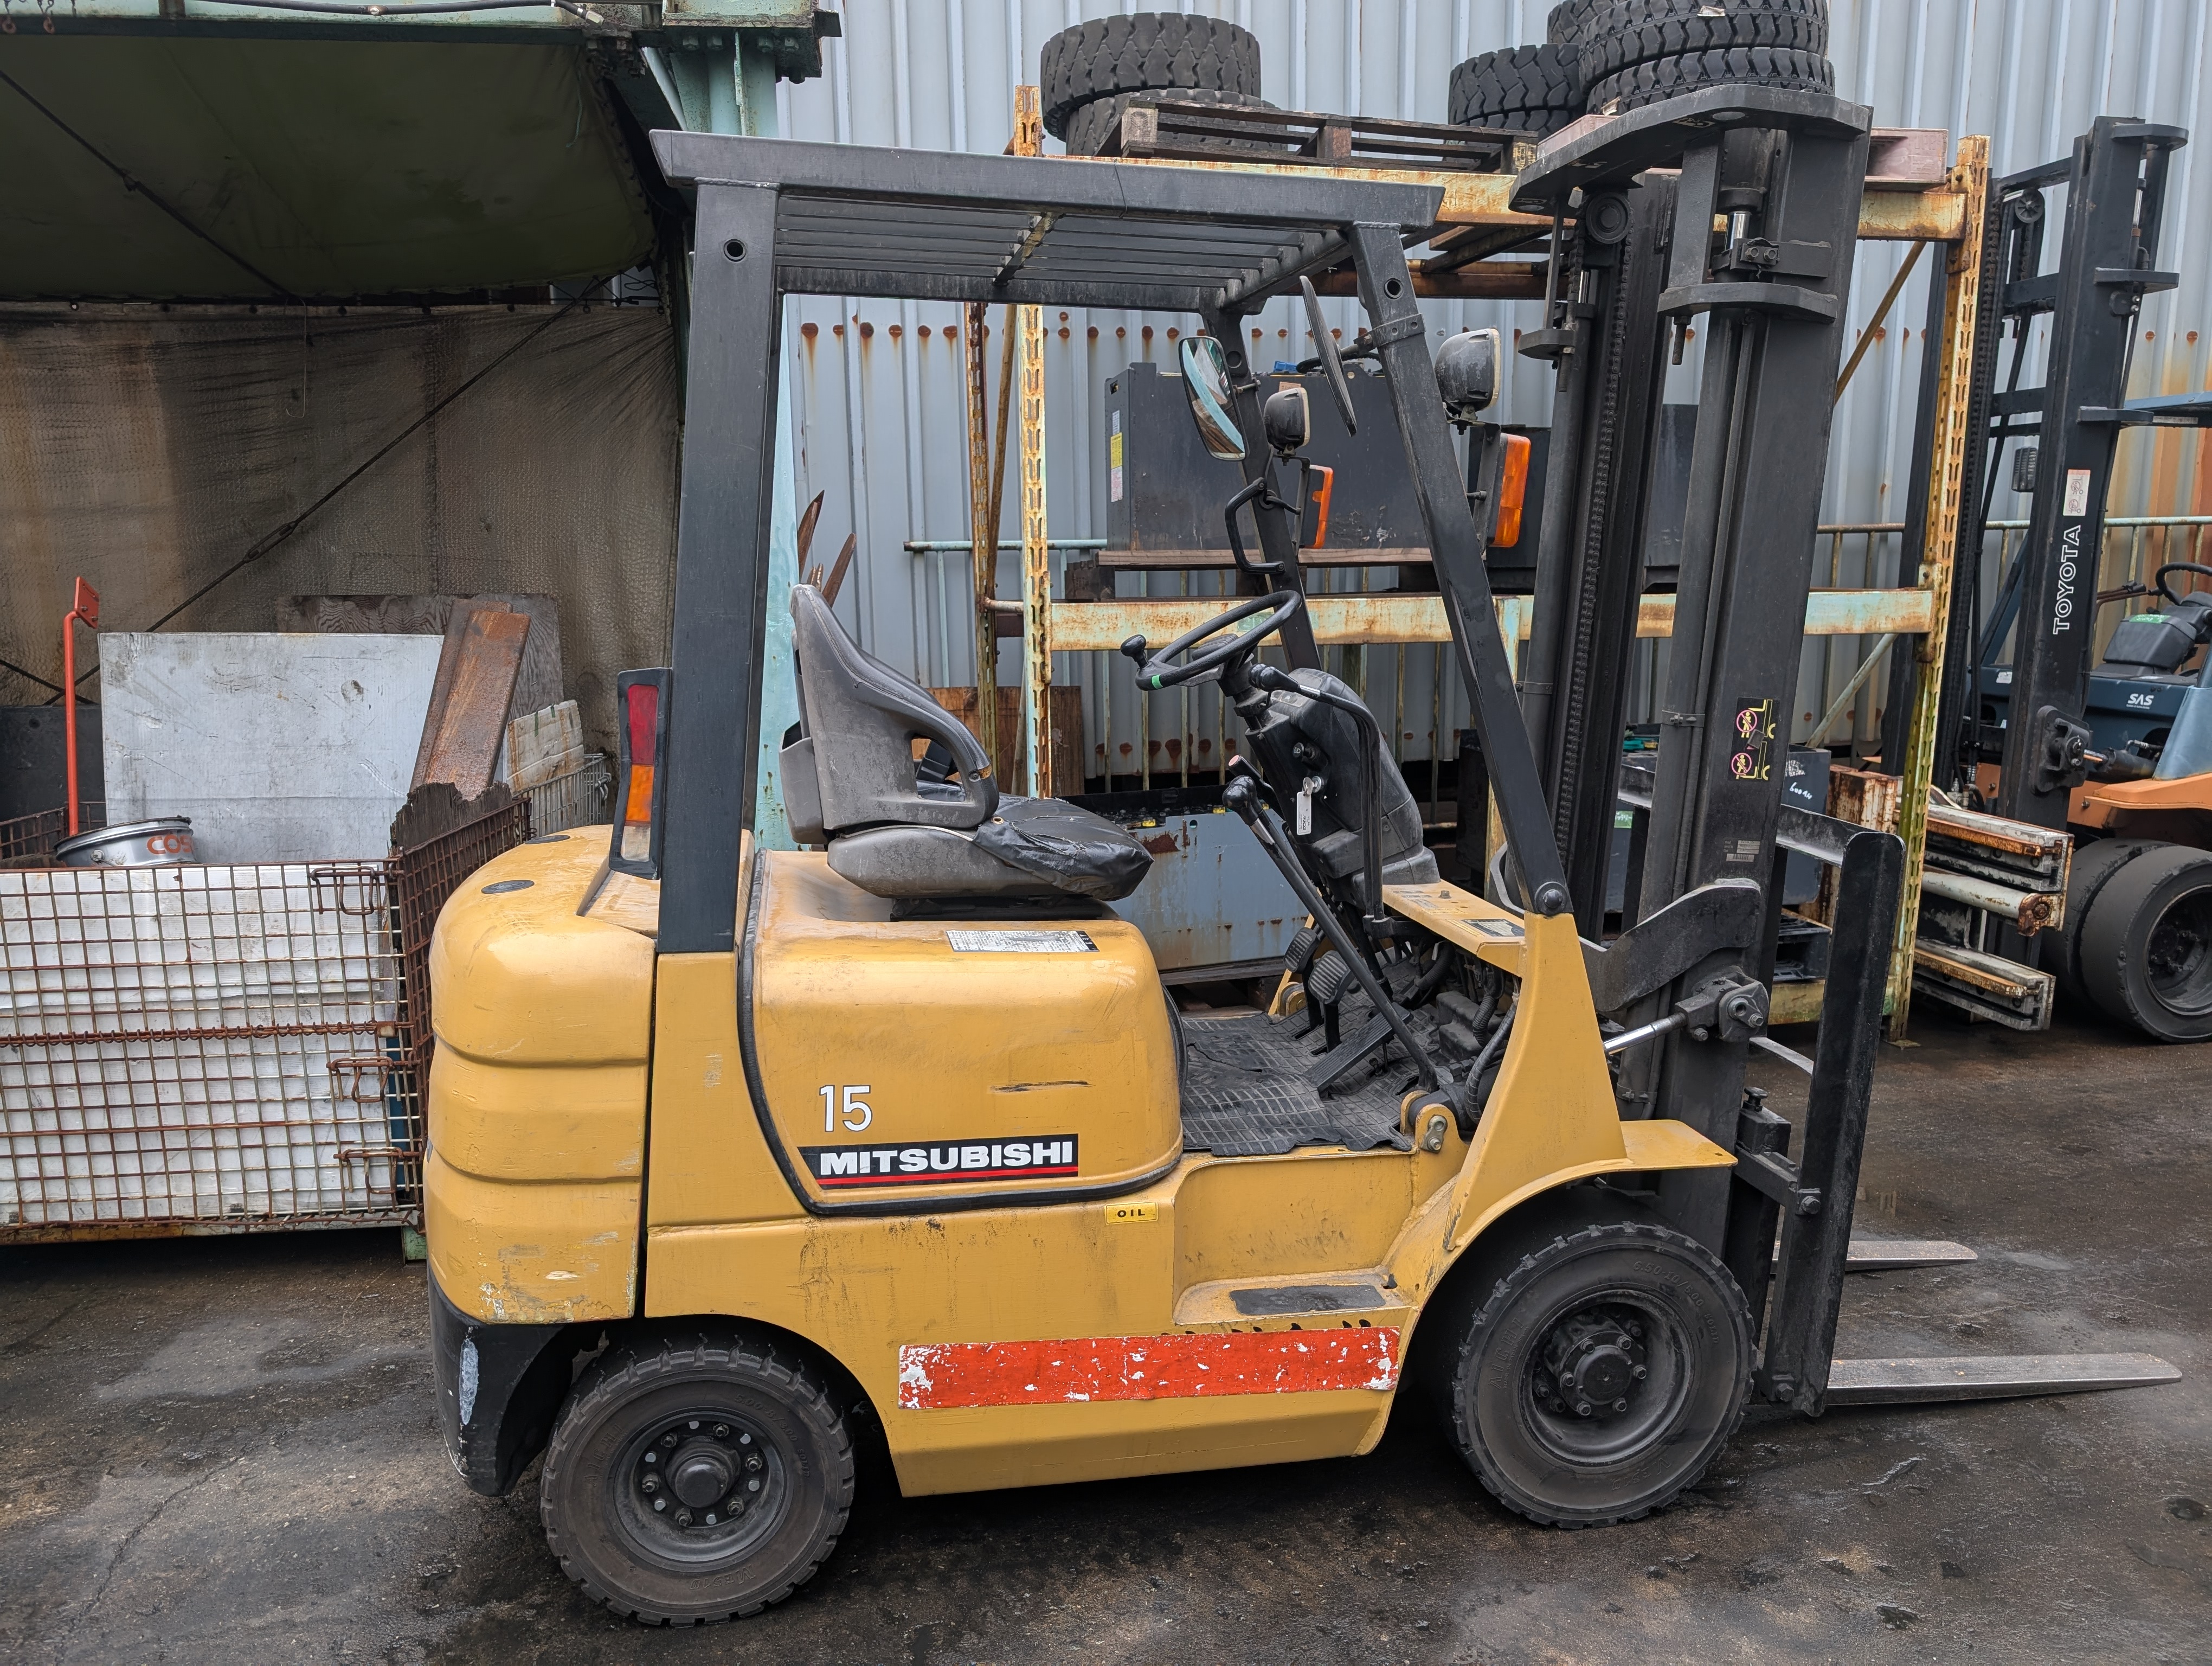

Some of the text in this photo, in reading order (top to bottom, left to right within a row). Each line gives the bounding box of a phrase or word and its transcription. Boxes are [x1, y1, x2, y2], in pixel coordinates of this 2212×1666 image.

[2053, 524, 2081, 635] TOYOTA
[2127, 693, 2154, 706] SAS
[819, 1084, 873, 1132] 15
[819, 1140, 1073, 1176] MITSUBISHI
[1117, 1208, 1146, 1218] OIL
[1489, 1317, 1525, 1391] AICHI
